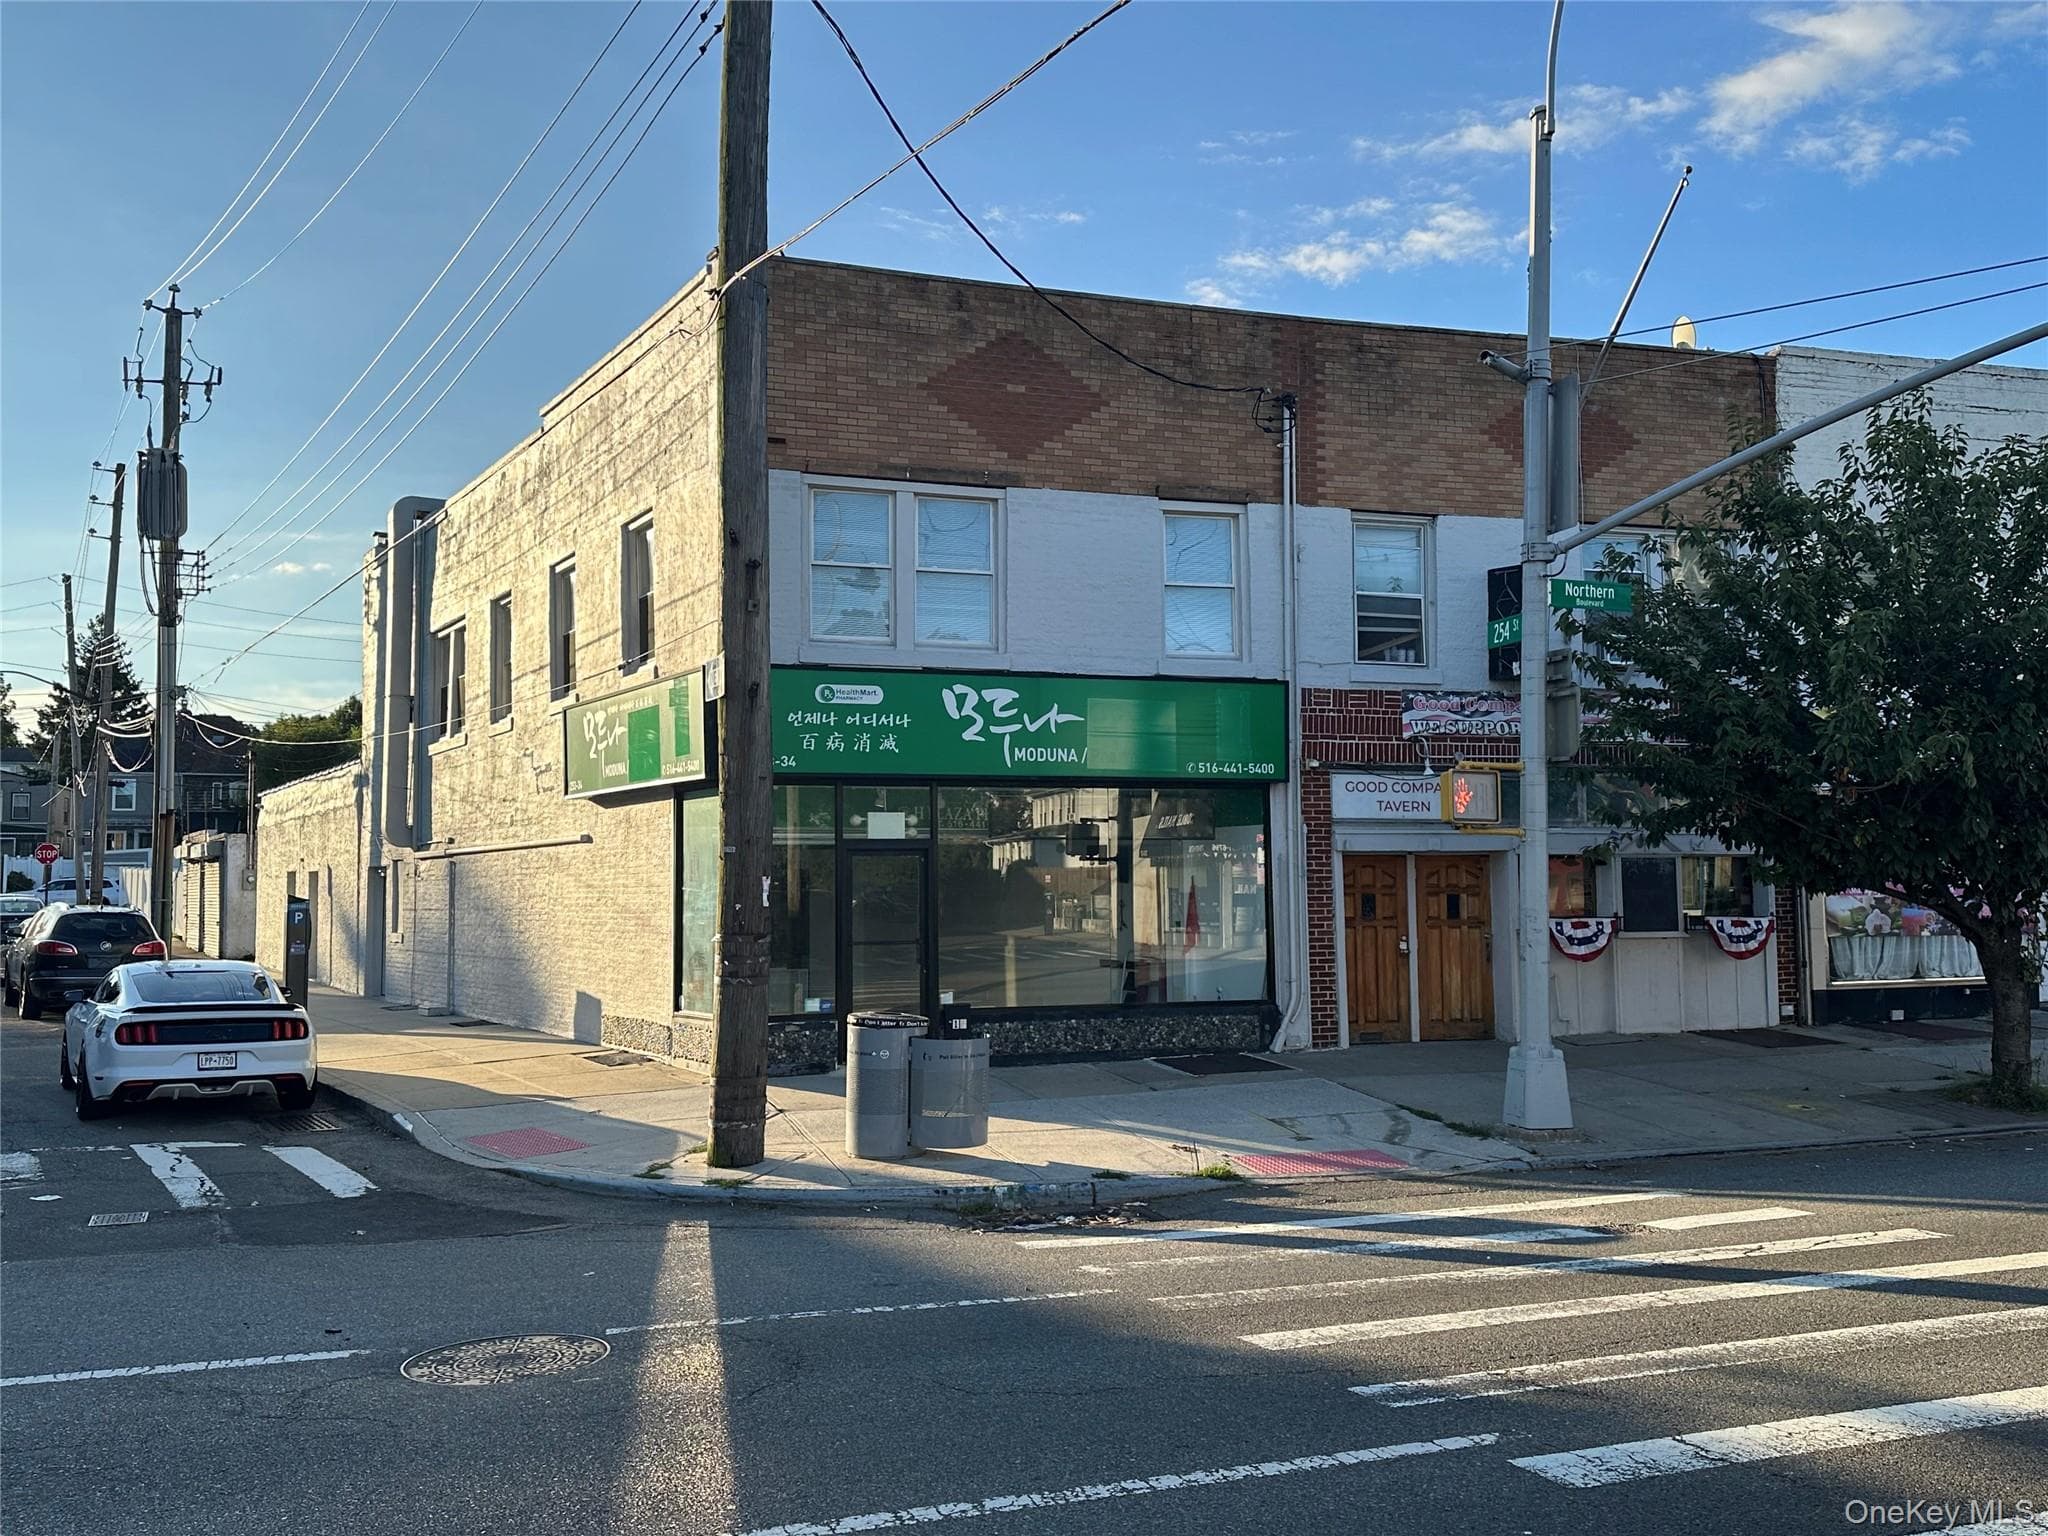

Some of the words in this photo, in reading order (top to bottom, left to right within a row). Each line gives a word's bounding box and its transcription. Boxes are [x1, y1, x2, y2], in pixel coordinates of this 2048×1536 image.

[1565, 582, 1614, 599] Northern
[1576, 598, 1604, 608] Boulevard
[1494, 621, 1510, 643] 254
[1413, 696, 1461, 711] Good
[788, 711, 838, 727] 언제나
[846, 712, 911, 728] 어디서나
[1411, 720, 1441, 734] WE
[1014, 747, 1078, 762] MODUNA
[605, 762, 627, 776] MODUNA
[1198, 762, 1275, 774] 516-441-5400
[1345, 781, 1388, 793] GOOD
[1376, 800, 1431, 812] TAVERN
[37, 850, 57, 859] STOP
[294, 912, 303, 924] P
